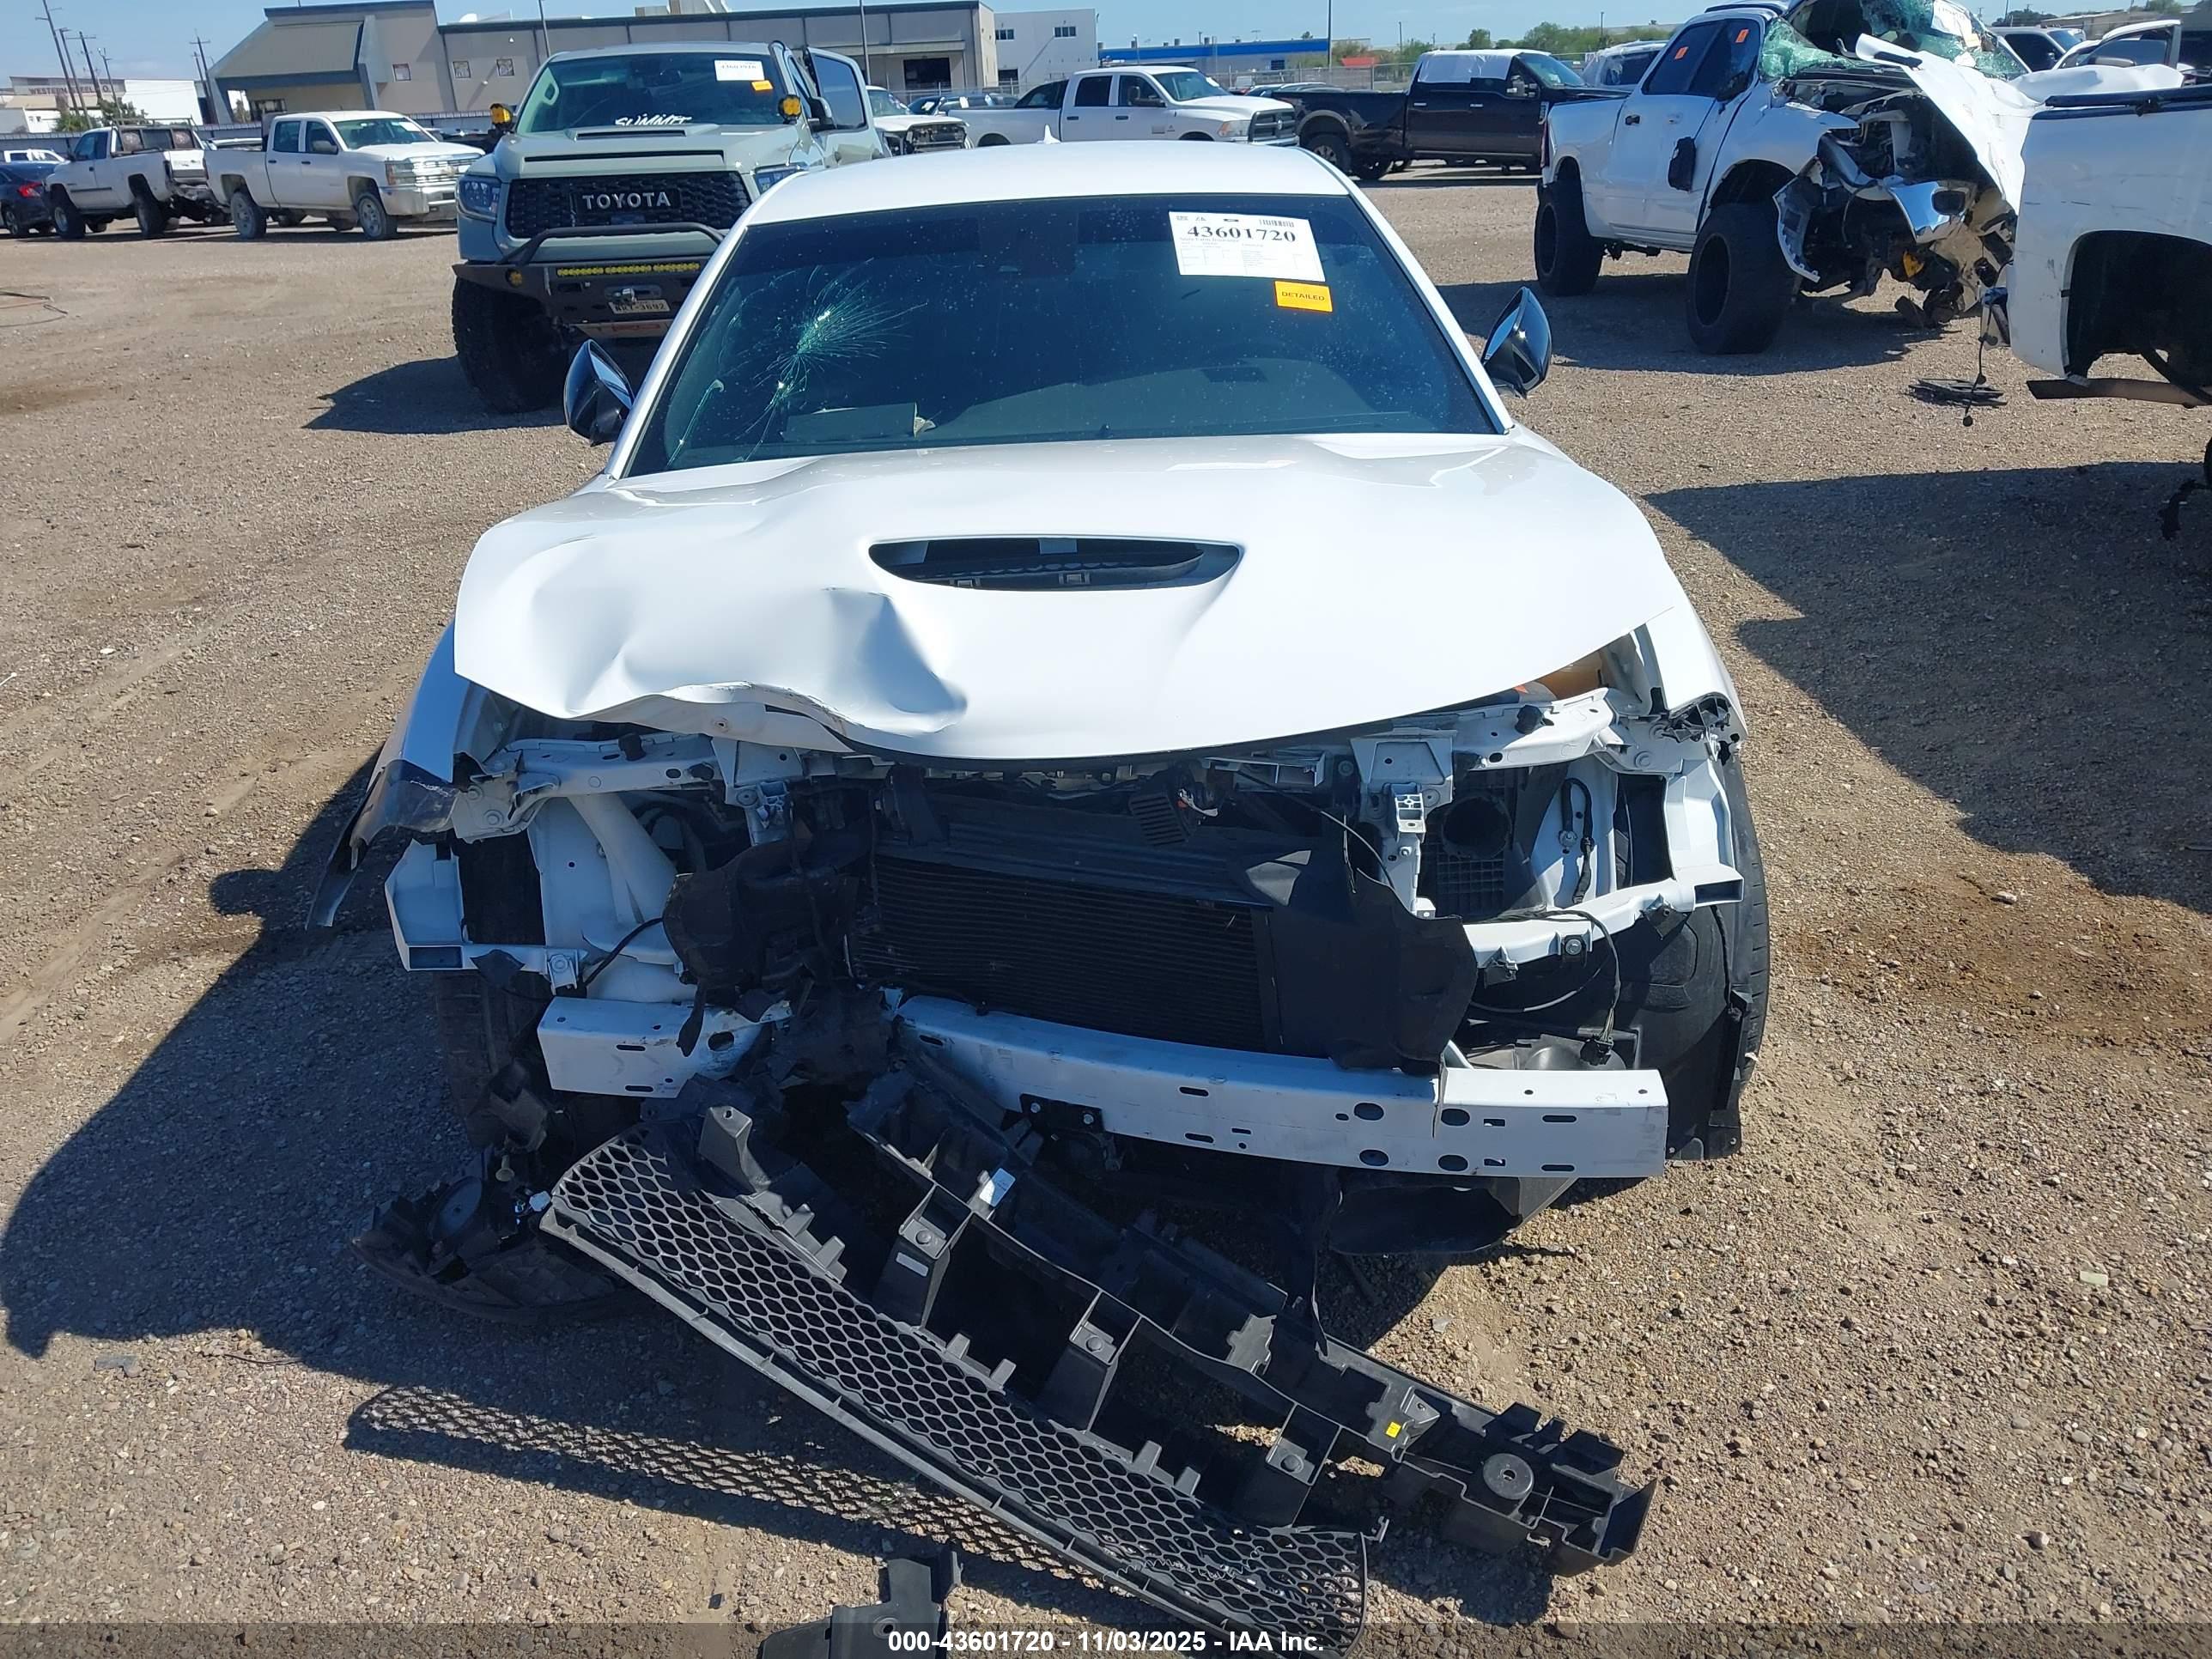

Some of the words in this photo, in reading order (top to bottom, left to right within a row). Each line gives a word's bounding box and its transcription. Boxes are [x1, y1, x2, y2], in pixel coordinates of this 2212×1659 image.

[582, 191, 672, 210] TOYOTA
[1188, 226, 1296, 242] 43601720
[1282, 291, 1325, 301] DETAILED
